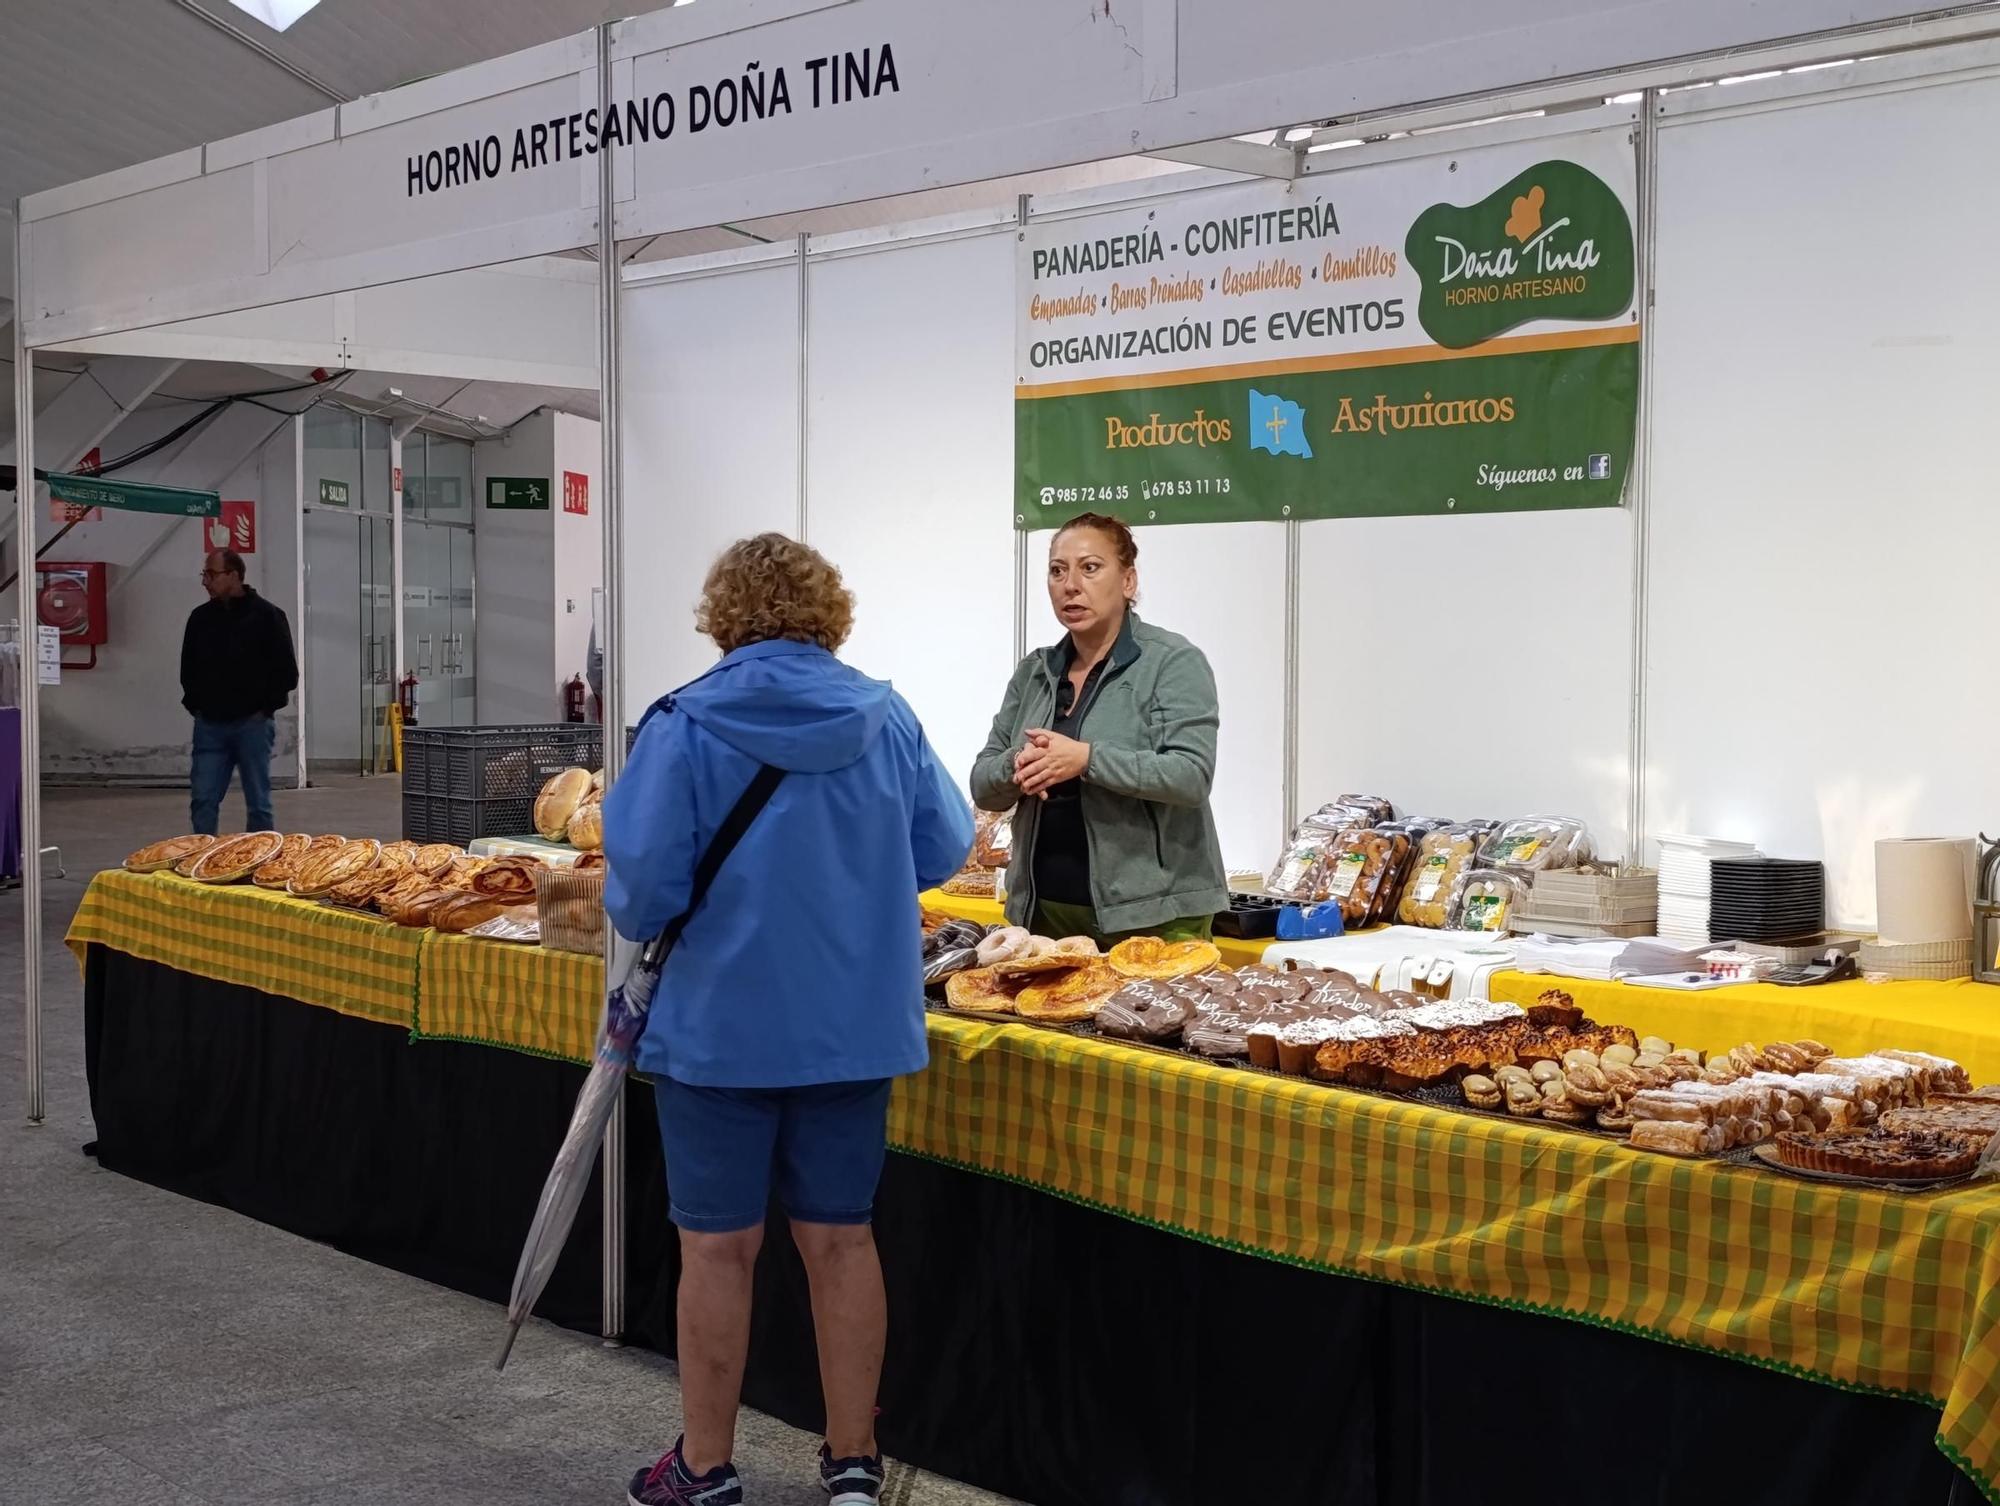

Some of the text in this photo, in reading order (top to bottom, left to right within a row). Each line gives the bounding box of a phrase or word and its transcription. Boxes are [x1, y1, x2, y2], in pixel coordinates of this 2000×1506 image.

[407, 43, 901, 197] HORNO ARTESANO DOÑA TINA
[1033, 225, 1165, 280] PANADERÍA
[1185, 196, 1341, 256] CONFITERÍA
[1435, 217, 1601, 284] Doña Tina
[1030, 245, 1397, 325] Empanadas Barras Preñadas Casadiellas Canutillos
[1445, 275, 1587, 307] HORNO ARTESANO
[1029, 298, 1405, 369] ORGANIZACIÓN DE EVENTOS
[1105, 391, 1516, 449] Productos Asturianos
[328, 484, 348, 502] SALIDA
[1056, 485, 1129, 502] 985 72 46 35
[1152, 478, 1231, 497] 678 53 11 13
[1476, 463, 1557, 492] Síguenos
[1563, 465, 1585, 481] en
[1121, 978, 1179, 1018] Kinder
[1312, 981, 1373, 1012] Kinder
